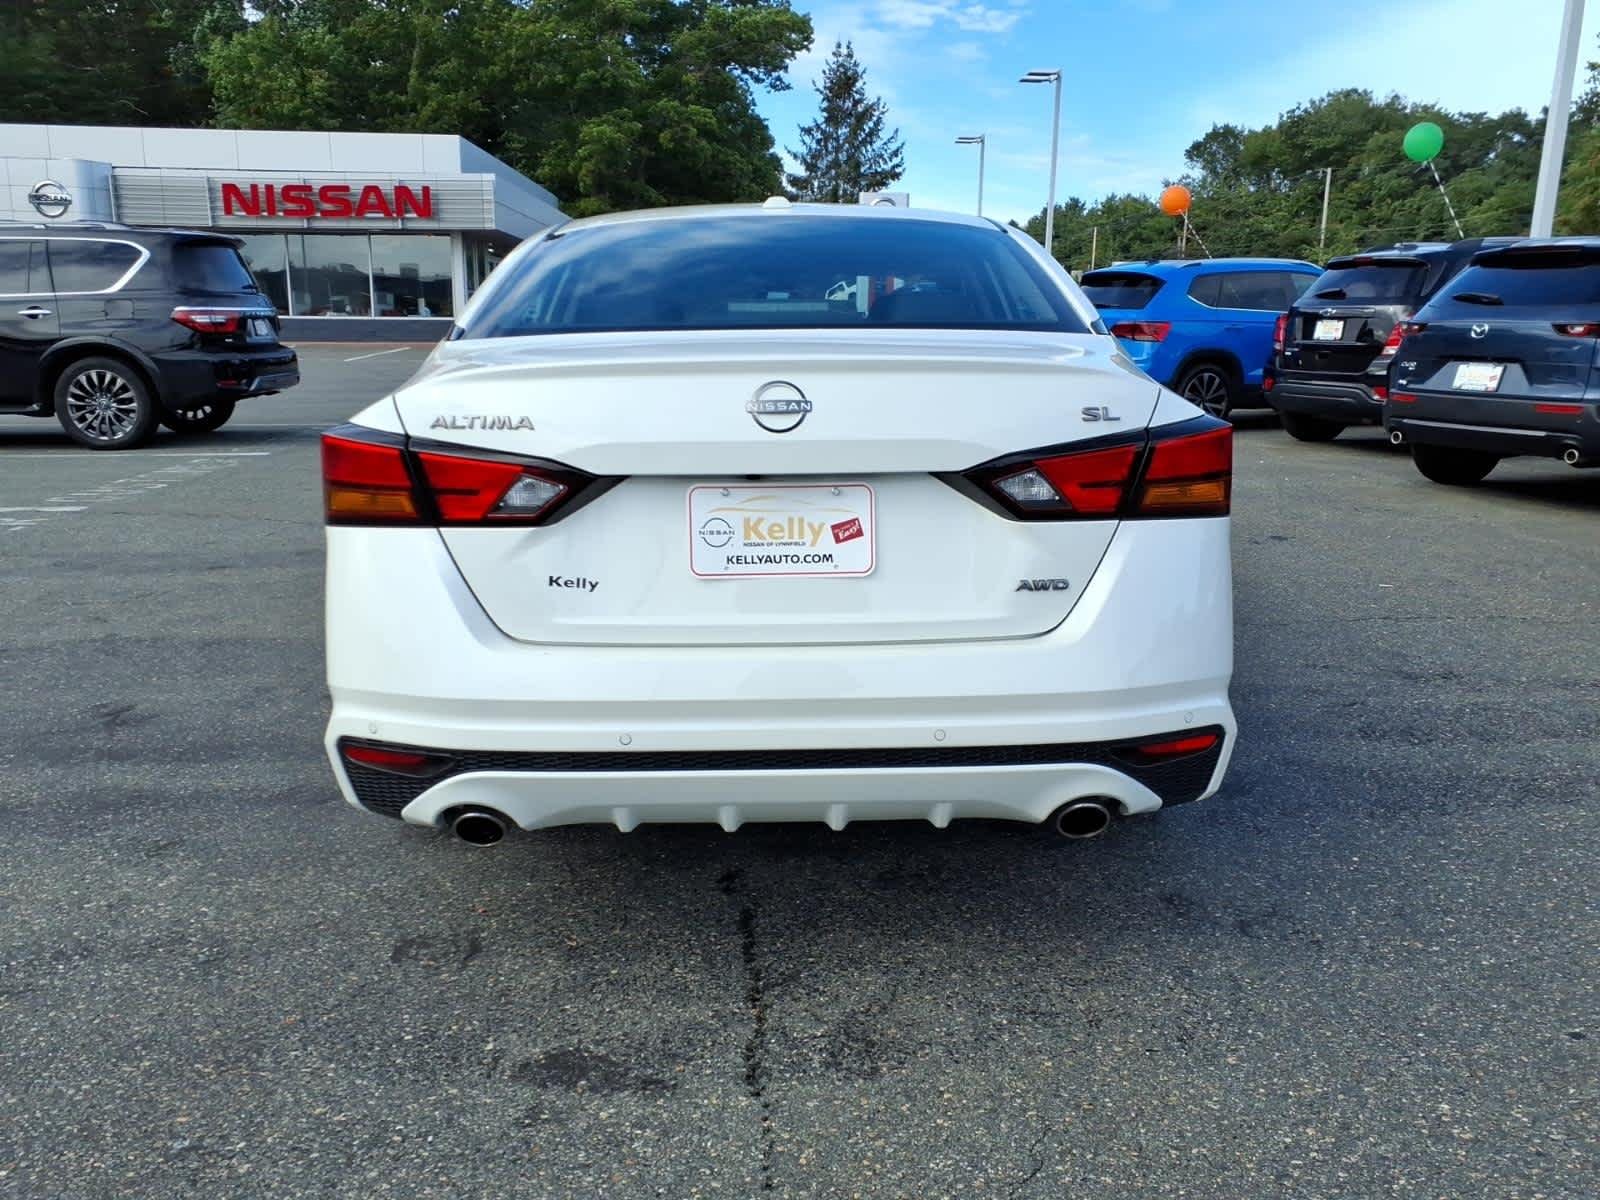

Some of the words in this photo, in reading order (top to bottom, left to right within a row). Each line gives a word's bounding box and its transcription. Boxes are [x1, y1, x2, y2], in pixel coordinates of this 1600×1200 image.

[221, 183, 433, 218] NISSAN
[746, 401, 812, 412] NISSAN
[1081, 406, 1121, 422] SL
[430, 415, 535, 431] ALTIMA
[743, 516, 825, 547] Kelly
[726, 553, 834, 565] KELLYAUTO.COM
[548, 575, 600, 593] Kelly
[1015, 579, 1070, 592] AWD
